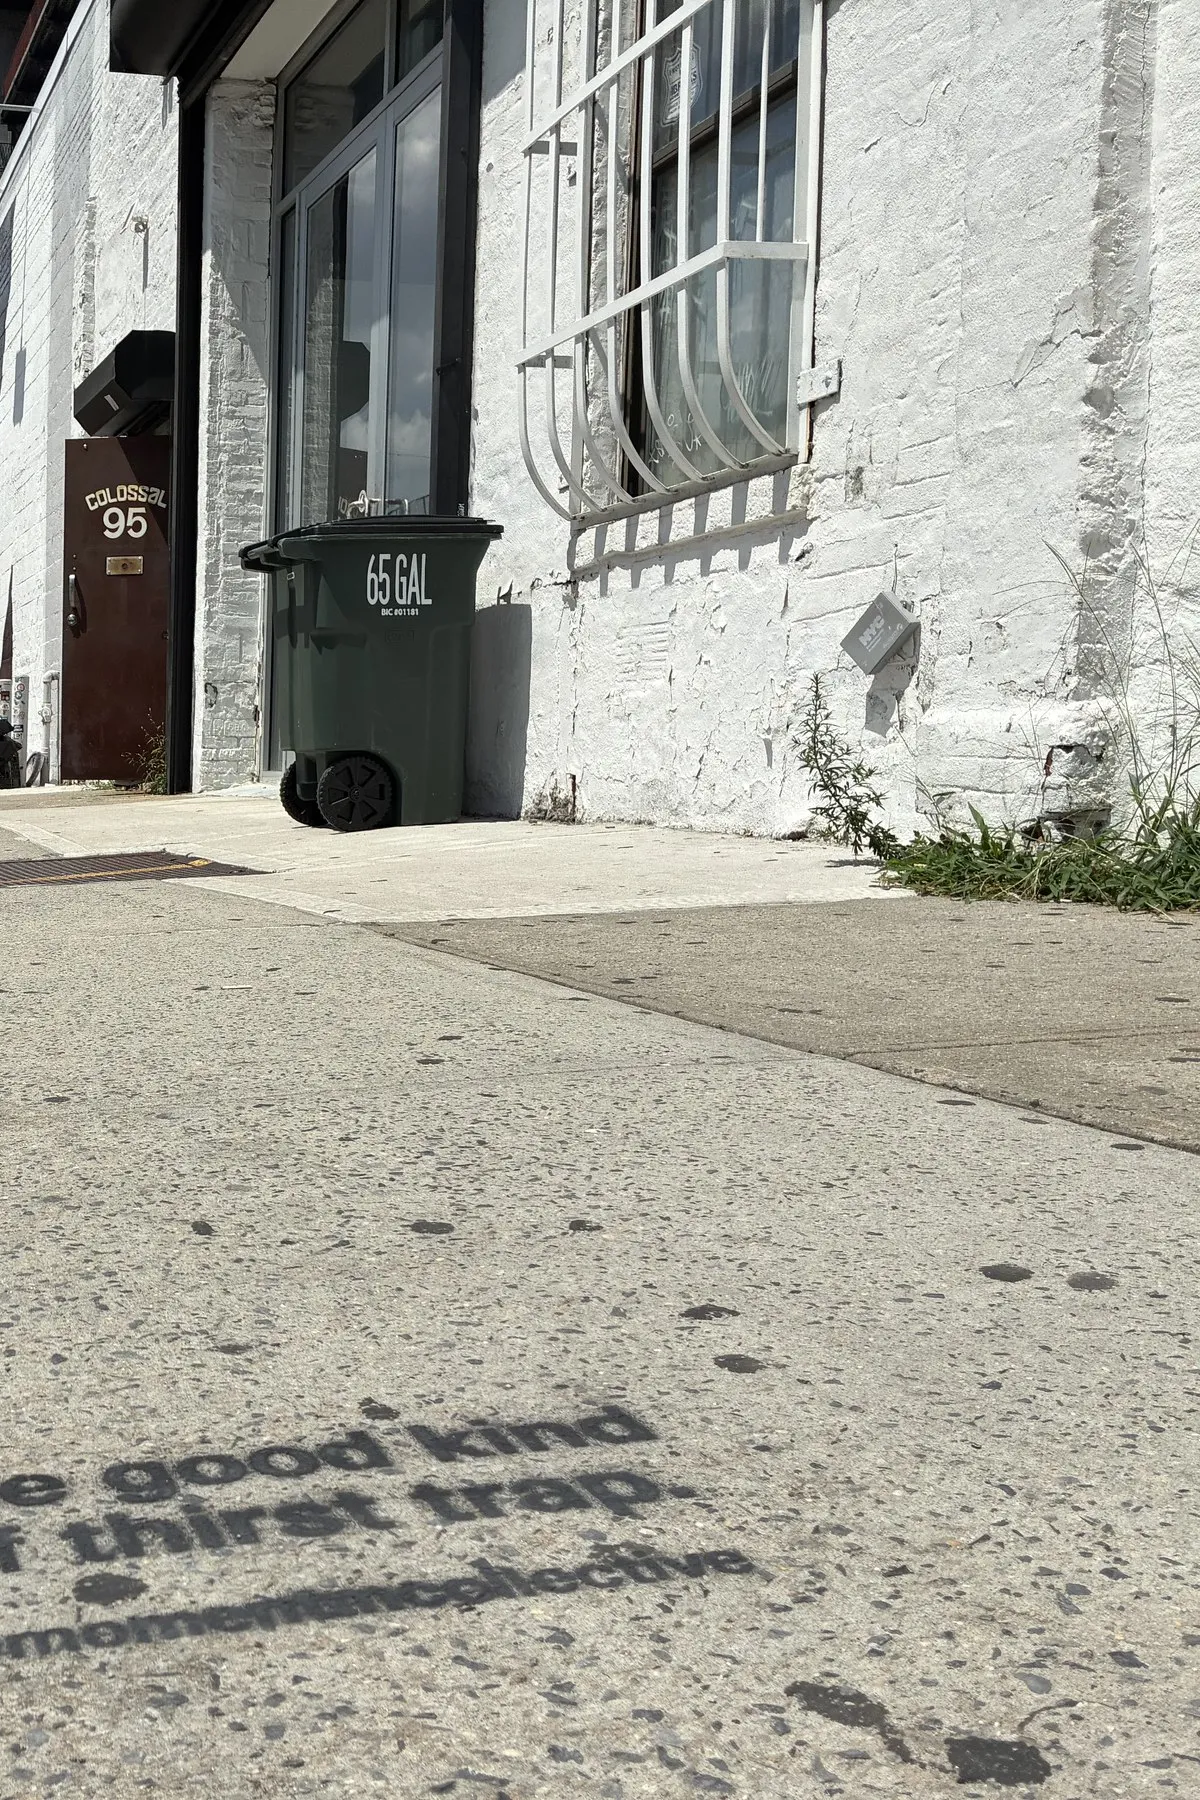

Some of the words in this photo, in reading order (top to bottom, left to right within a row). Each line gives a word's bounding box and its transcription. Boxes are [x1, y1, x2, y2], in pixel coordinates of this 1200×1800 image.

[103, 507, 148, 539] 95
[366, 553, 391, 605] 65
[395, 553, 433, 605] GAL
[381, 608, 393, 616] BIC
[102, 1430, 392, 1504] good
[402, 1405, 660, 1462] kind
[60, 1491, 402, 1563] thirst
